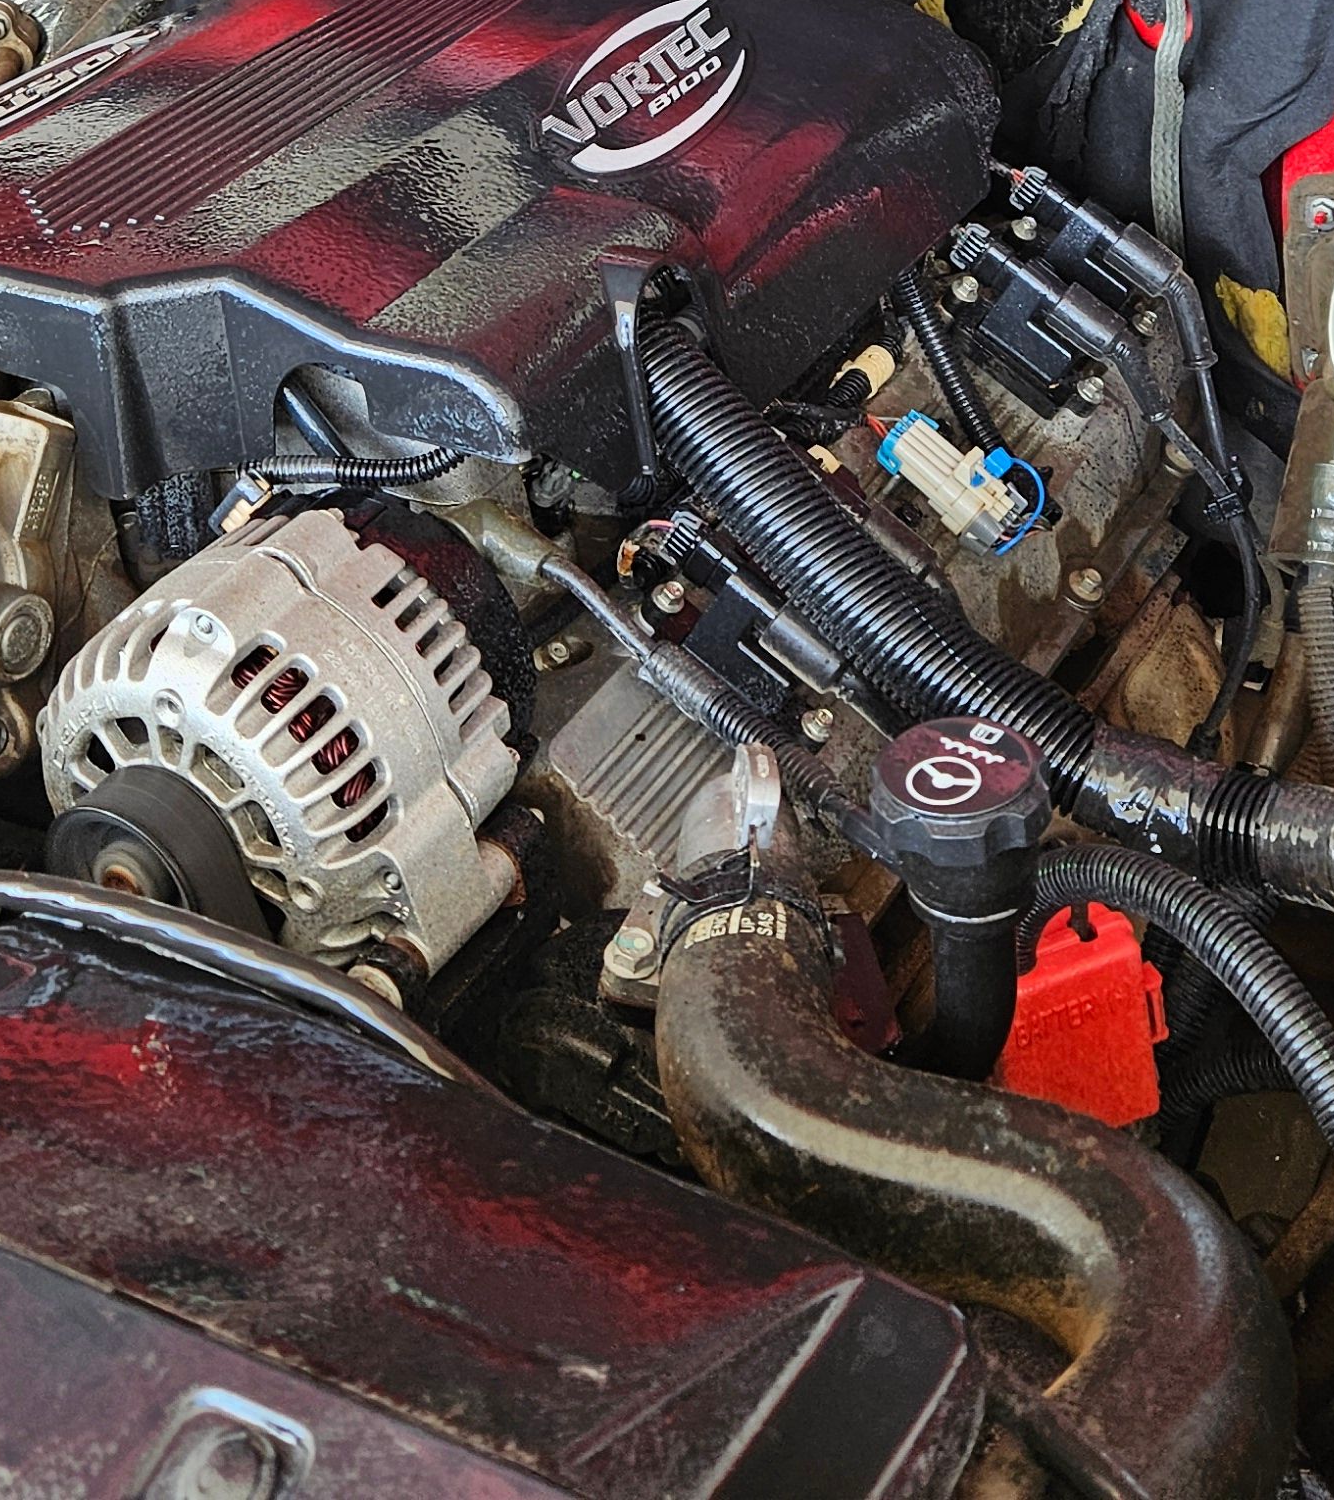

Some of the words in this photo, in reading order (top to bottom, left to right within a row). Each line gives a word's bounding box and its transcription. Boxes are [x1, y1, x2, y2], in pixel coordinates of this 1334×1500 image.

[541, 7, 731, 143] VORTEC
[648, 55, 722, 118] 8100
[740, 917, 756, 934] UP
[756, 912, 775, 937] SAS
